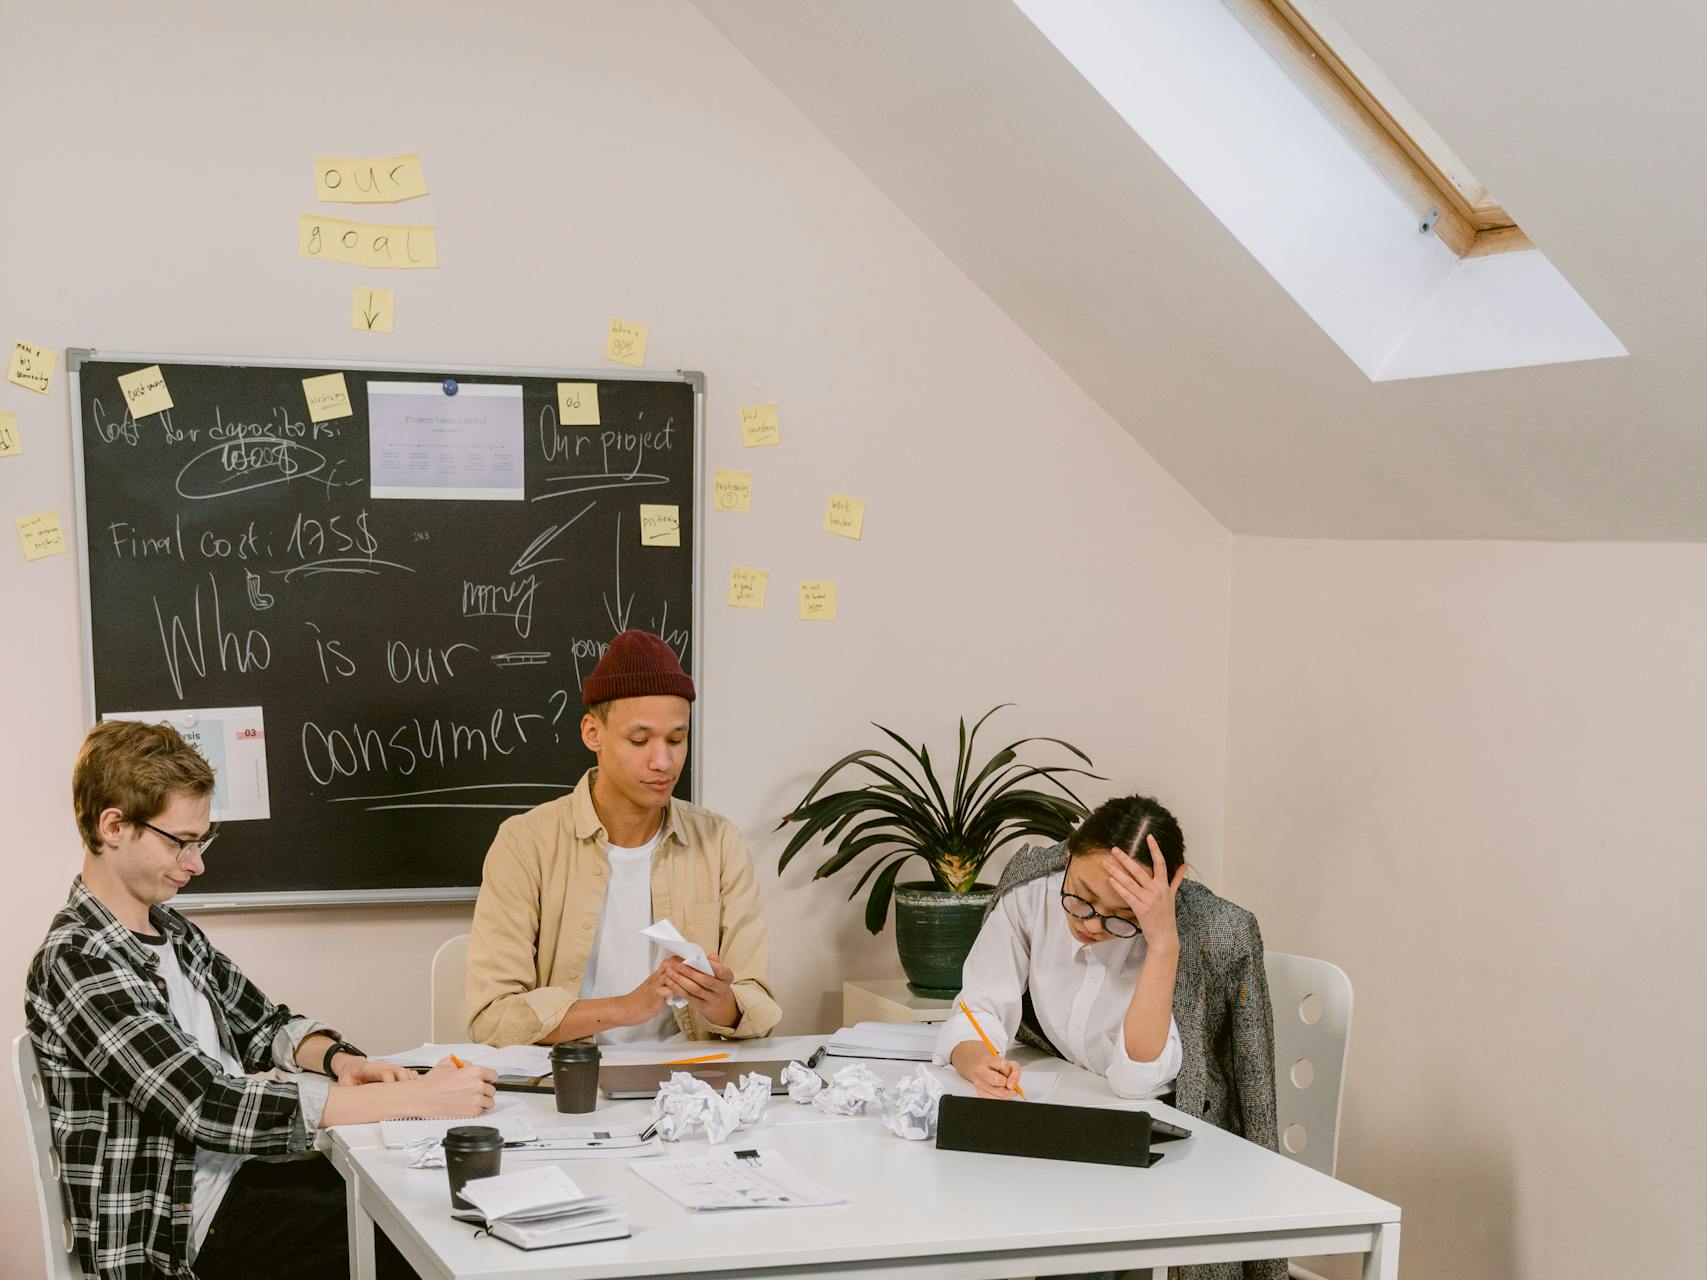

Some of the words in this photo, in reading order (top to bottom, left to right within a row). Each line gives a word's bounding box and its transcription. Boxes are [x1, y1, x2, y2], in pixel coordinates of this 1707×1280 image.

[325, 163, 406, 195] our
[307, 226, 422, 263] goal
[540, 404, 591, 461] Our
[601, 411, 676, 480] project
[108, 514, 185, 562] Final
[153, 571, 271, 700] Who
[304, 621, 356, 683] is
[388, 638, 480, 685] our
[244, 728, 257, 738] 03
